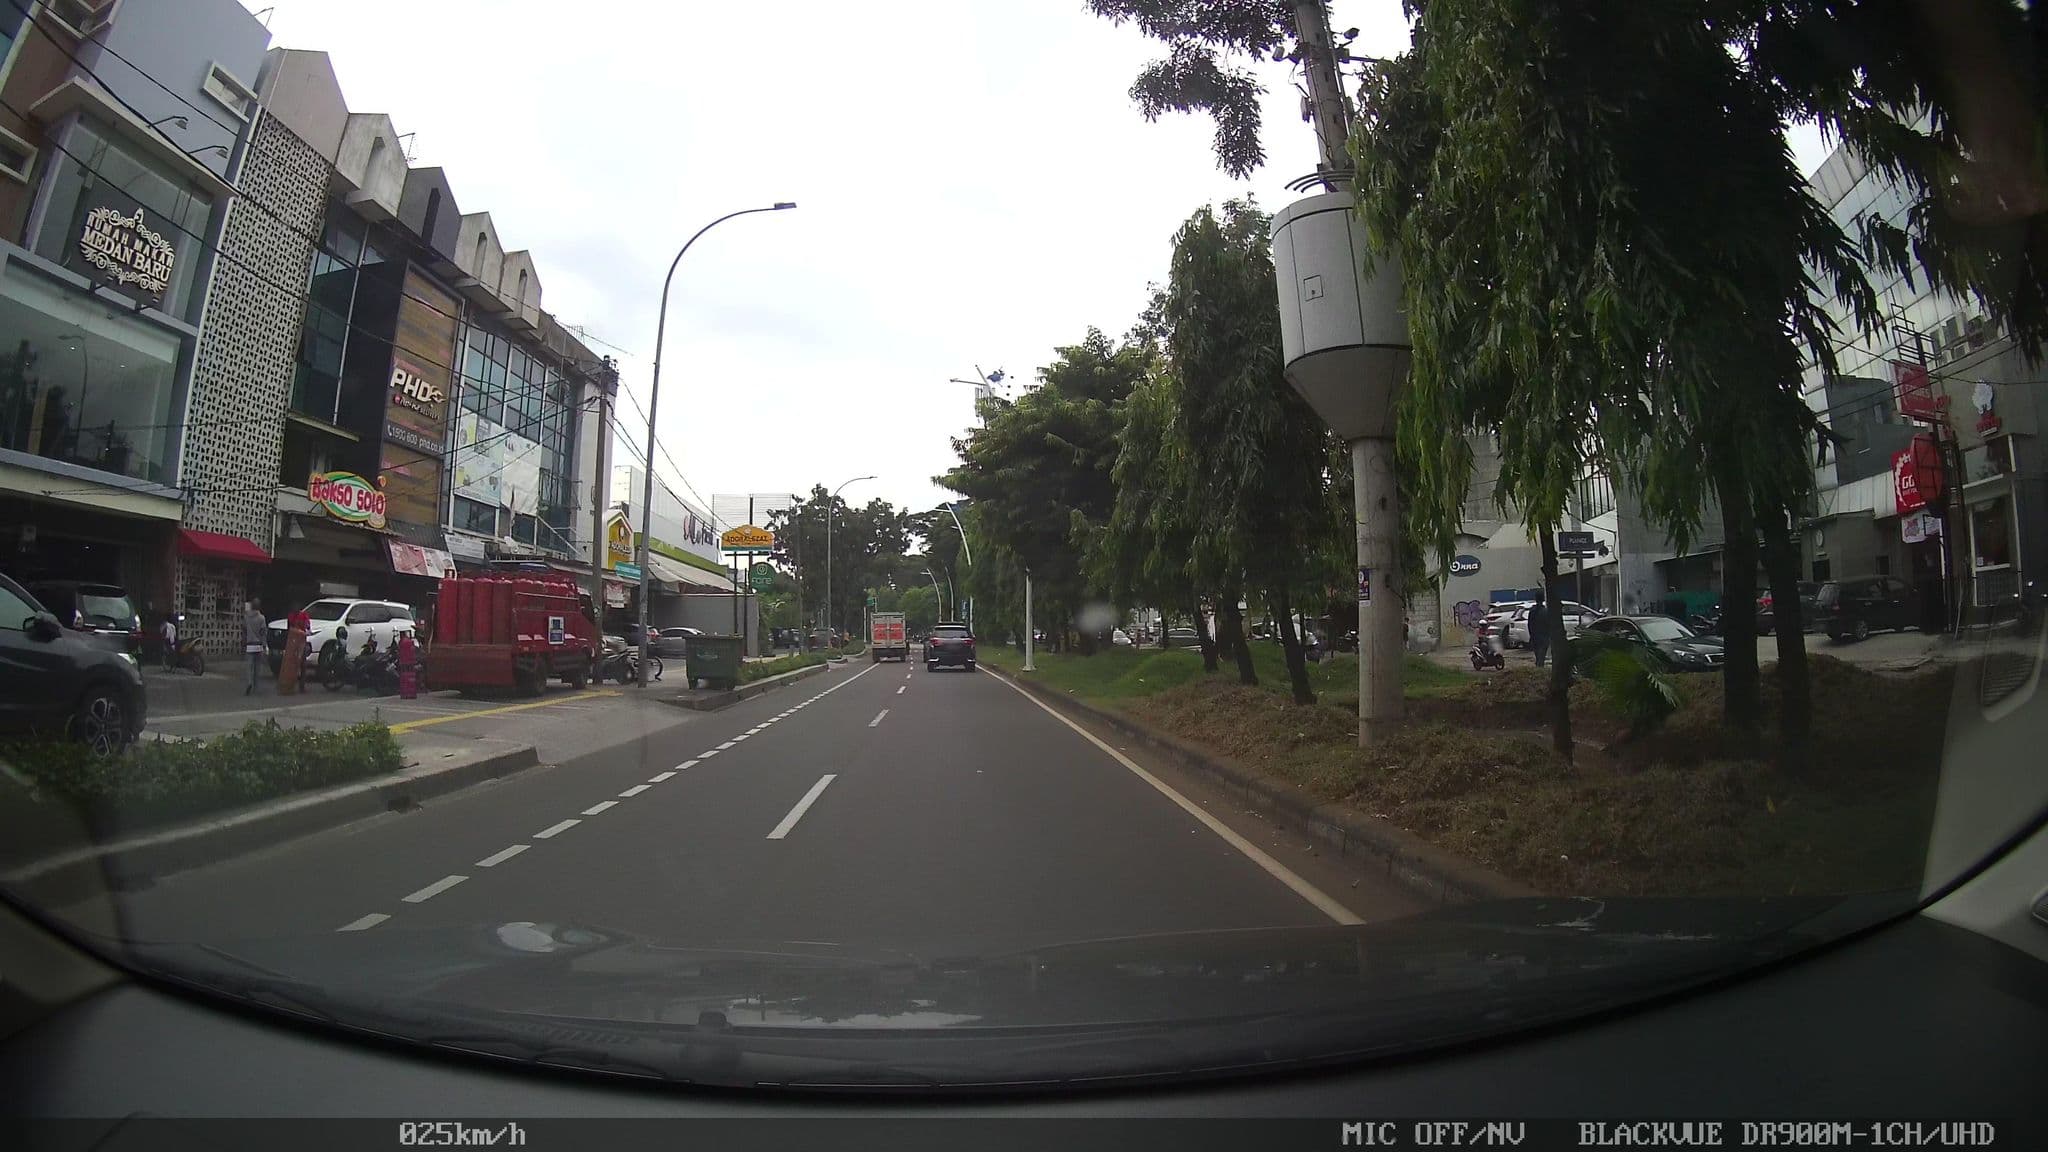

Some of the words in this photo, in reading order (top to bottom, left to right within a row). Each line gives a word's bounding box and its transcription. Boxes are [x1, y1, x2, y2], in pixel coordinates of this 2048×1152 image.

[81, 225, 135, 265] MEDAN
[133, 251, 172, 282] BARU
[86, 212, 130, 245] RUMAH
[133, 238, 175, 268] MAKAN
[389, 367, 432, 402] PHD
